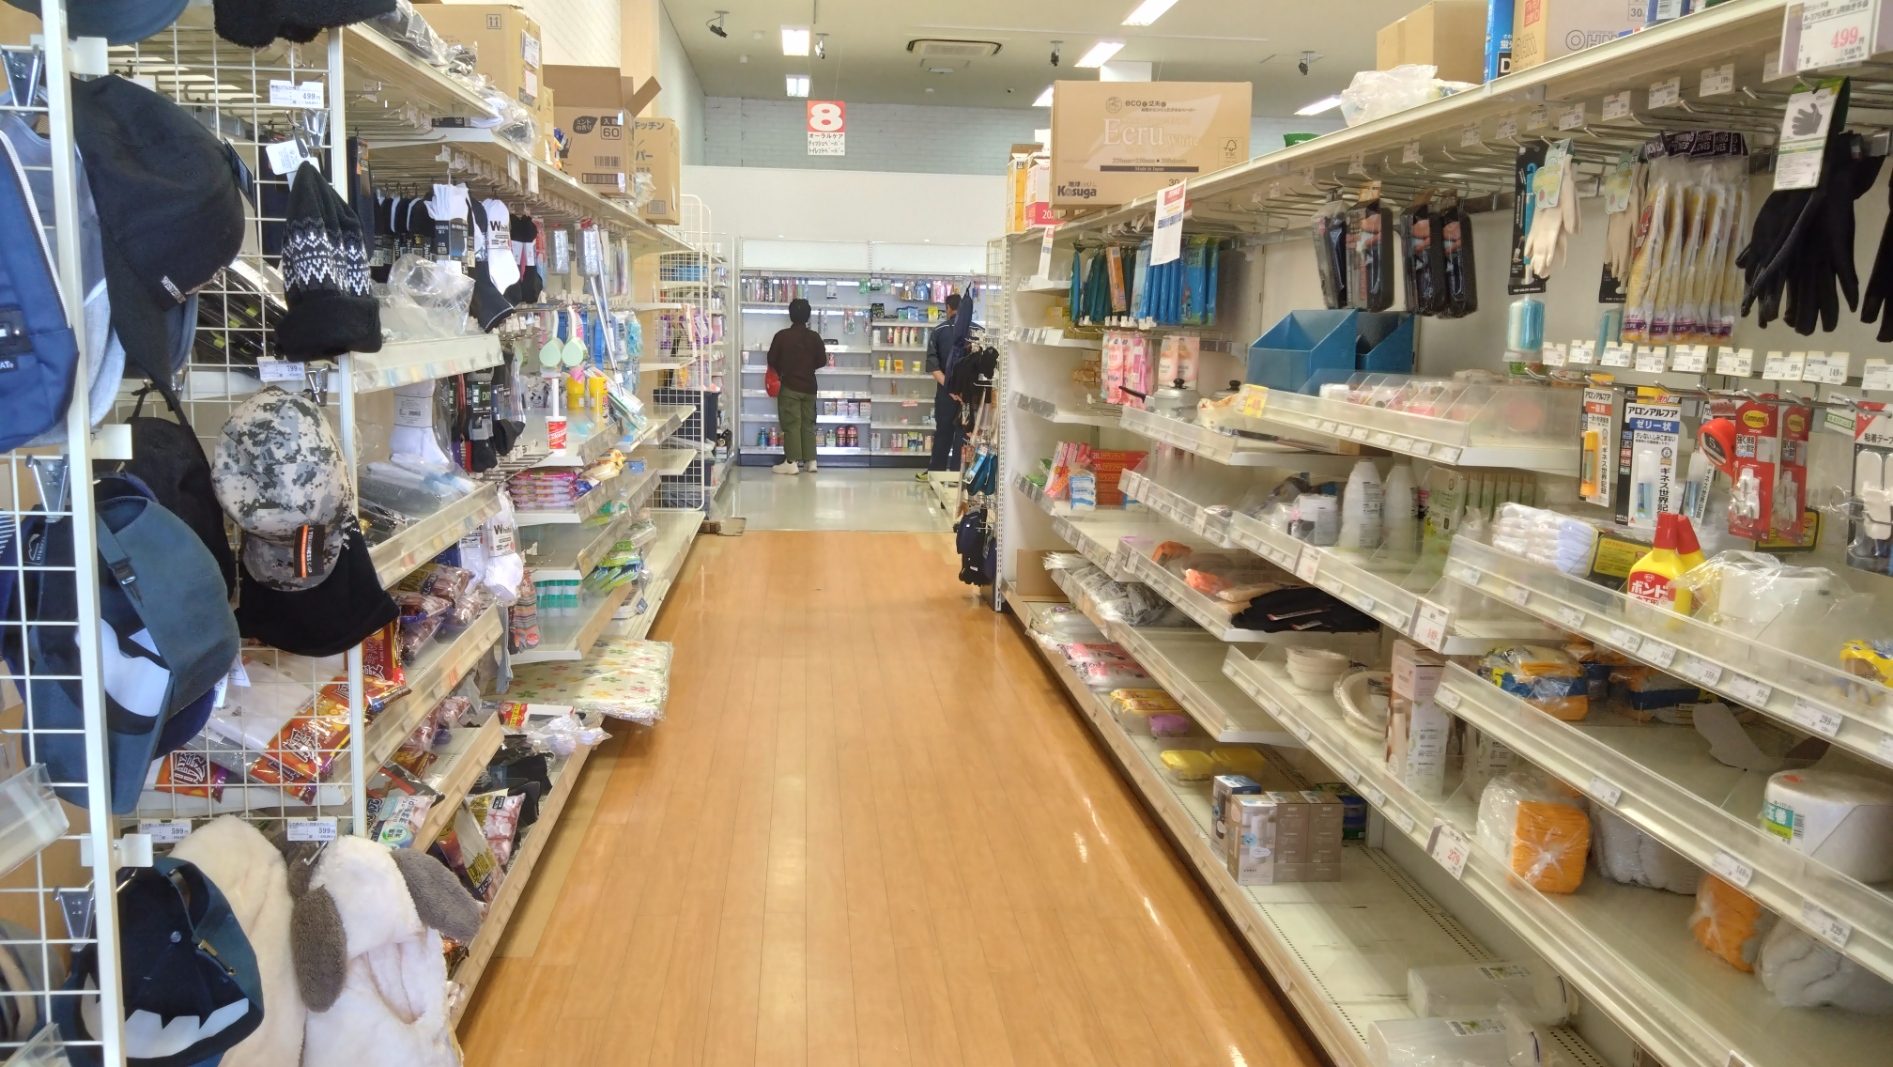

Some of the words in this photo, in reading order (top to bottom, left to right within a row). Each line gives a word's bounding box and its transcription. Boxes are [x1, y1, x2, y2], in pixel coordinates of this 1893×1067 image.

[810, 103, 843, 131] 8
[603, 128, 619, 137] 60
[1103, 118, 1164, 146] Ecru
[1635, 420, 1672, 432] ゼリー状
[1631, 580, 1669, 598] ボンド
